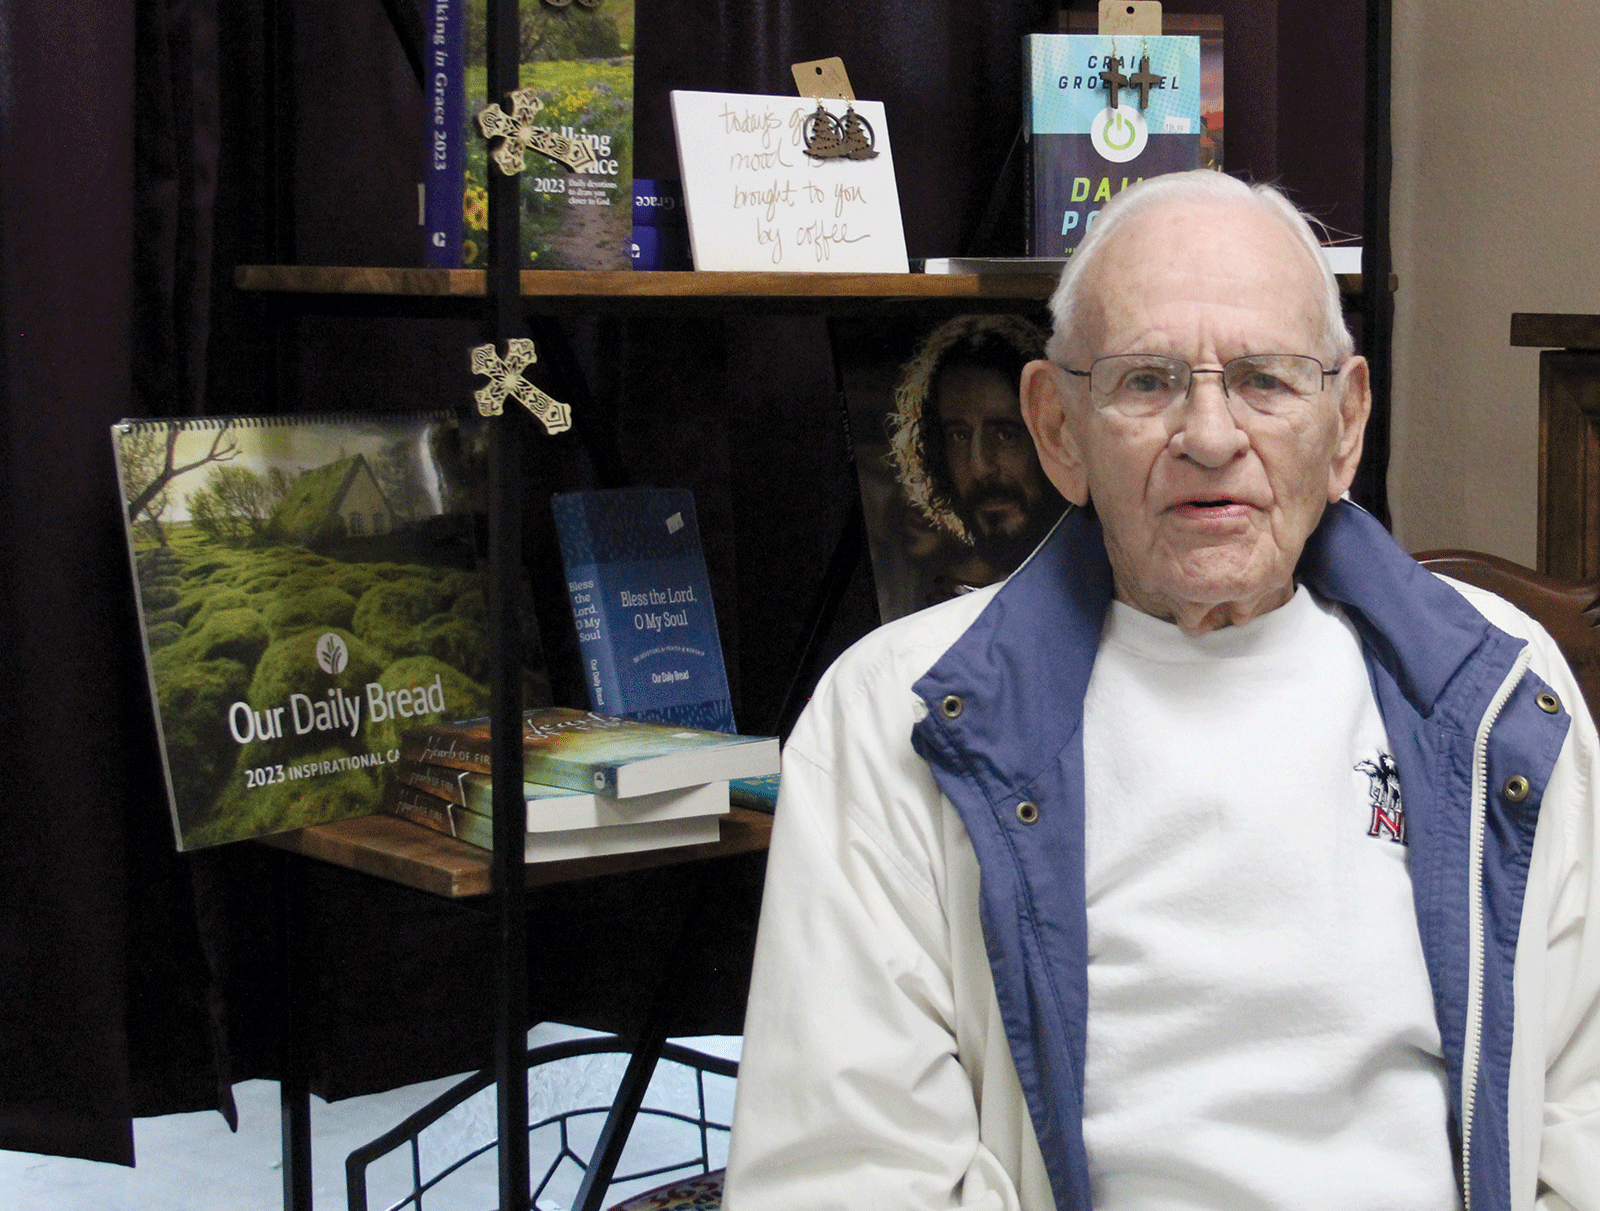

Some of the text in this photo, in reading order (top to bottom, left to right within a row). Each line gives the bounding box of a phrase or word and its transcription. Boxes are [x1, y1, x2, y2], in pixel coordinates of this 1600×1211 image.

[434, 50, 449, 68] in
[1087, 55, 1142, 69] CRAI
[433, 72, 449, 126] Grace
[719, 102, 783, 150] today's
[433, 129, 449, 171] 2023
[730, 138, 794, 172] mood
[533, 177, 566, 194] 2023
[635, 195, 676, 211] Grace
[734, 180, 867, 222] brought to you
[756, 217, 872, 265] by coffee
[569, 580, 595, 592] Bless
[574, 593, 591, 604] the
[620, 590, 649, 607] Bless
[649, 588, 667, 604] the
[575, 618, 601, 630] O My
[634, 610, 688, 632] O My Soul
[579, 630, 601, 642] Soul
[652, 673, 661, 684] Our
[228, 674, 446, 744] Our Daily Bread
[459, 750, 471, 761] OF
[475, 753, 492, 766] FIR
[245, 764, 286, 788] 2023
[289, 752, 385, 781] INSPIRATIONAL
